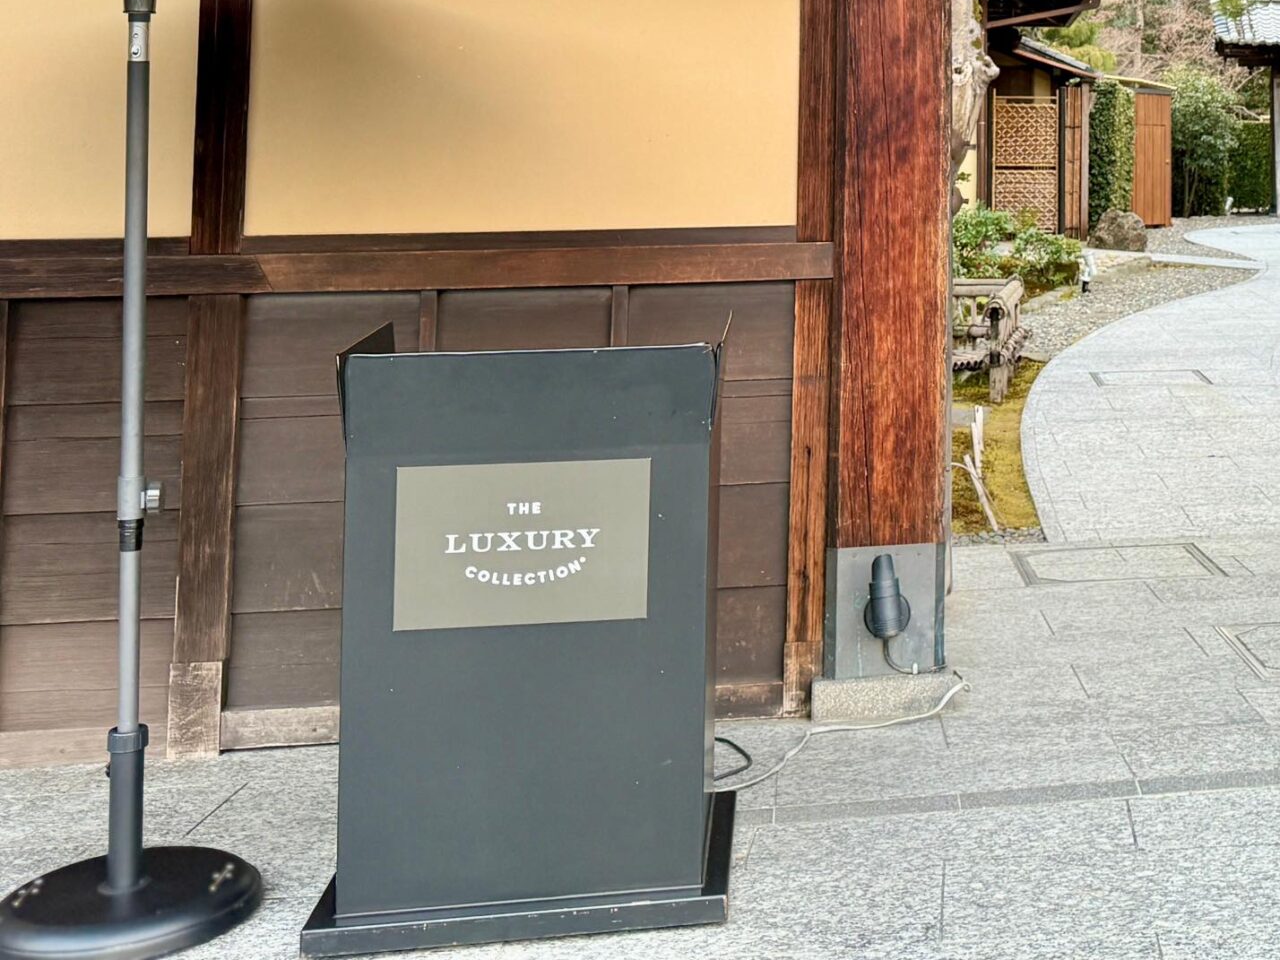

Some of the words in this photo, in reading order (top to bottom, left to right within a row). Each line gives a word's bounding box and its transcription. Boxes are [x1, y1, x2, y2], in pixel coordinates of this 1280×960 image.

[506, 501, 542, 516] THE
[444, 528, 601, 554] LUXURY
[464, 557, 586, 586] COLLECTION
